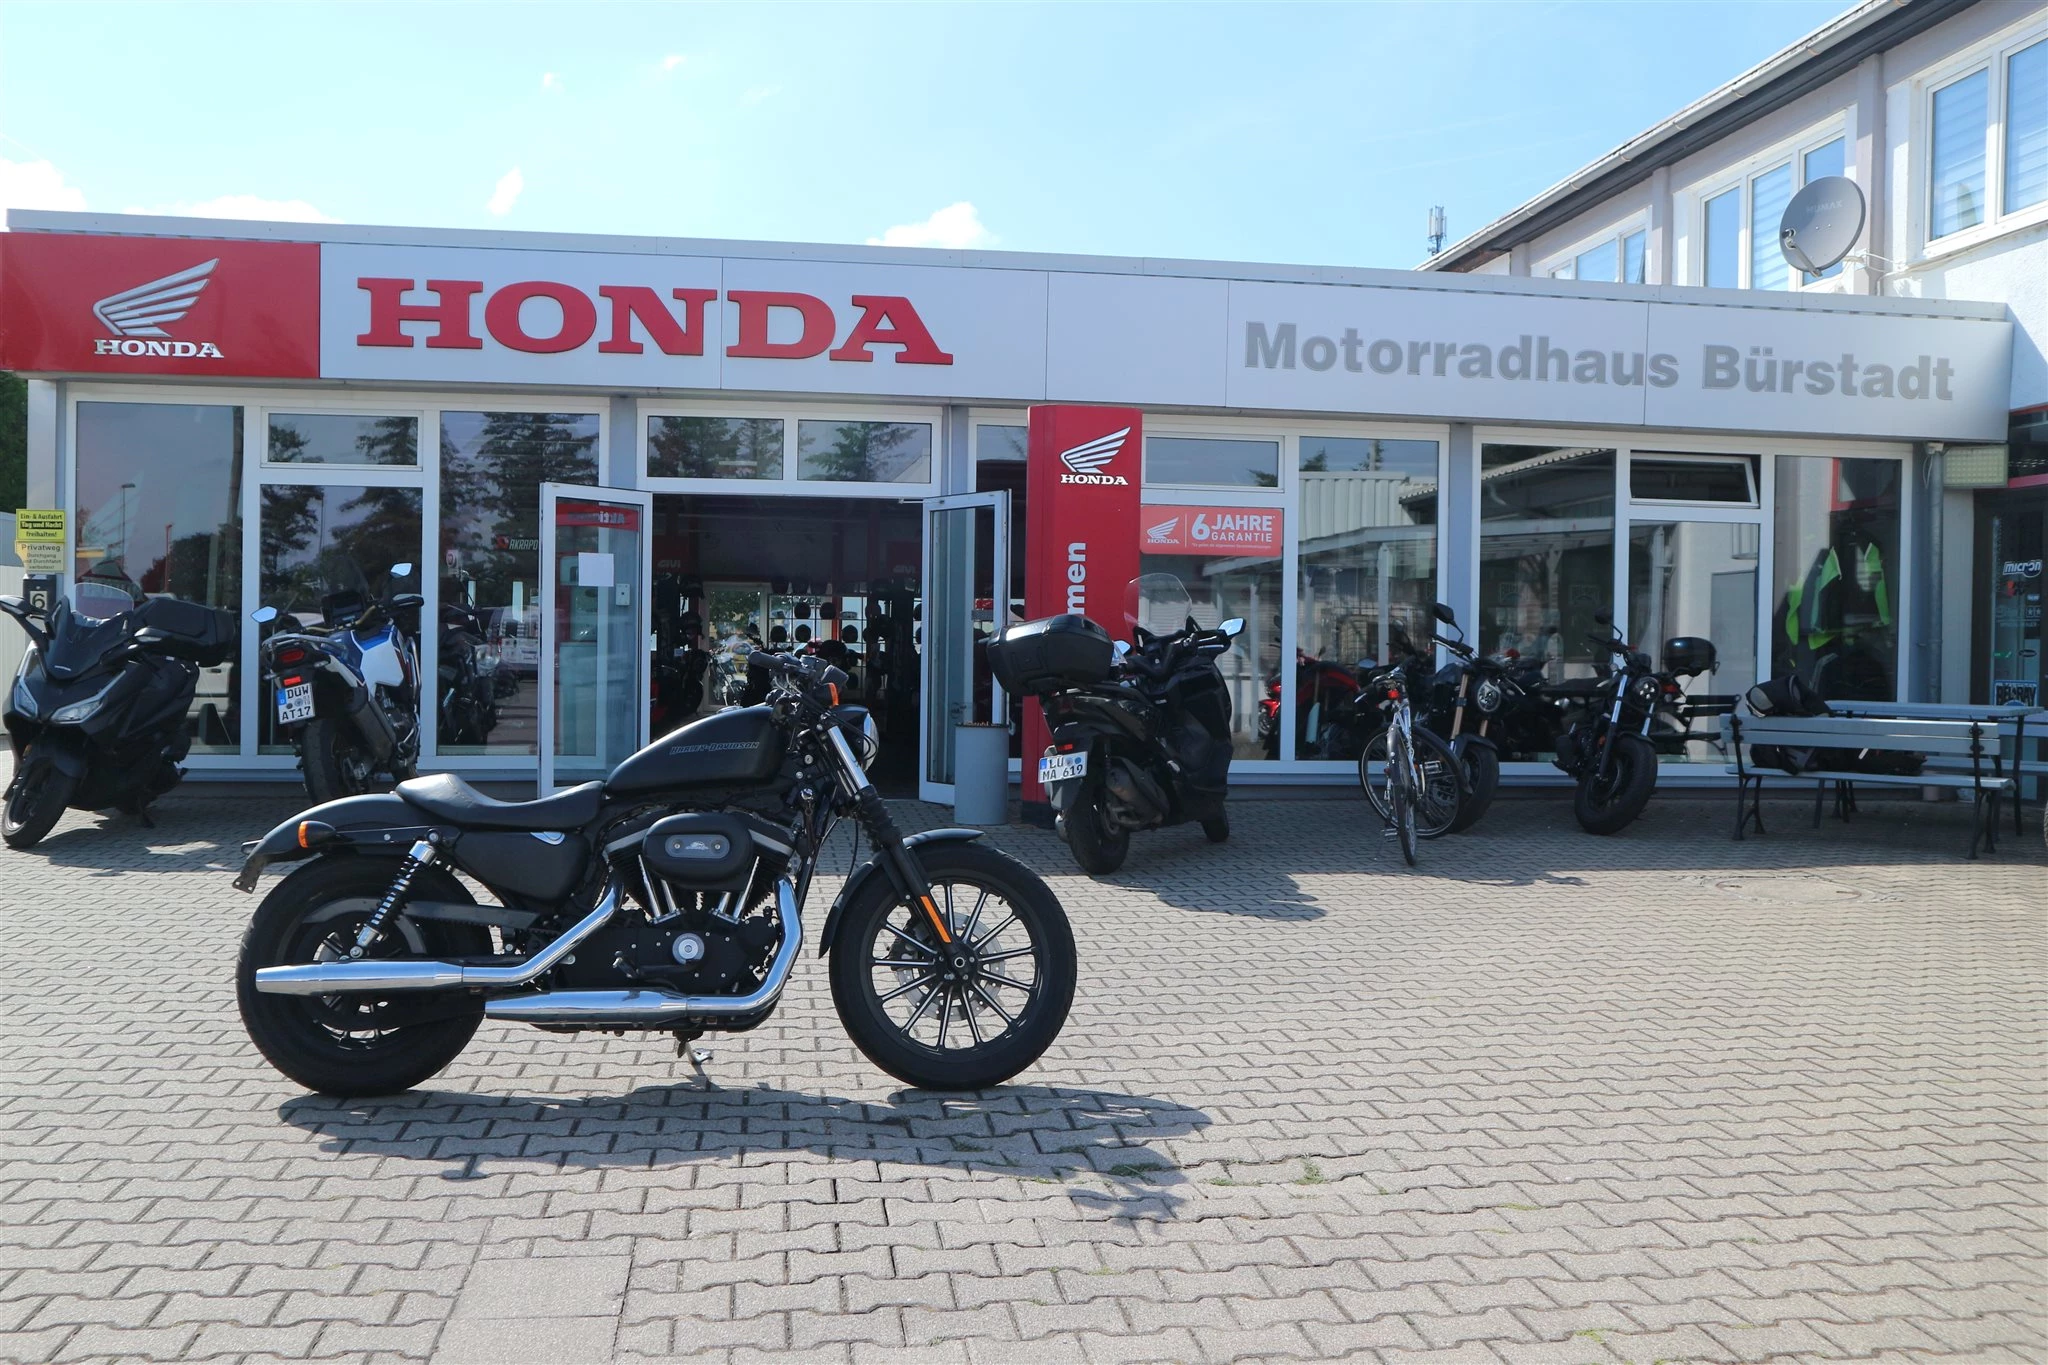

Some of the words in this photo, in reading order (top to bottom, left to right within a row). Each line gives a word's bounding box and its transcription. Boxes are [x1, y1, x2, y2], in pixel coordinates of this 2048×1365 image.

[357, 277, 953, 365] HONDA
[94, 339, 224, 358] HONDA
[1245, 320, 1680, 389] Motorradhaus
[1701, 343, 1956, 400] Bürstadt
[1060, 474, 1128, 486] HONDA
[1191, 513, 1211, 541] 6
[1211, 532, 1272, 542] GARANTIE
[21, 544, 61, 552] Privatweg
[32, 594, 45, 609] 6
[1043, 769, 1057, 780] MA
[1063, 764, 1083, 777] 619
